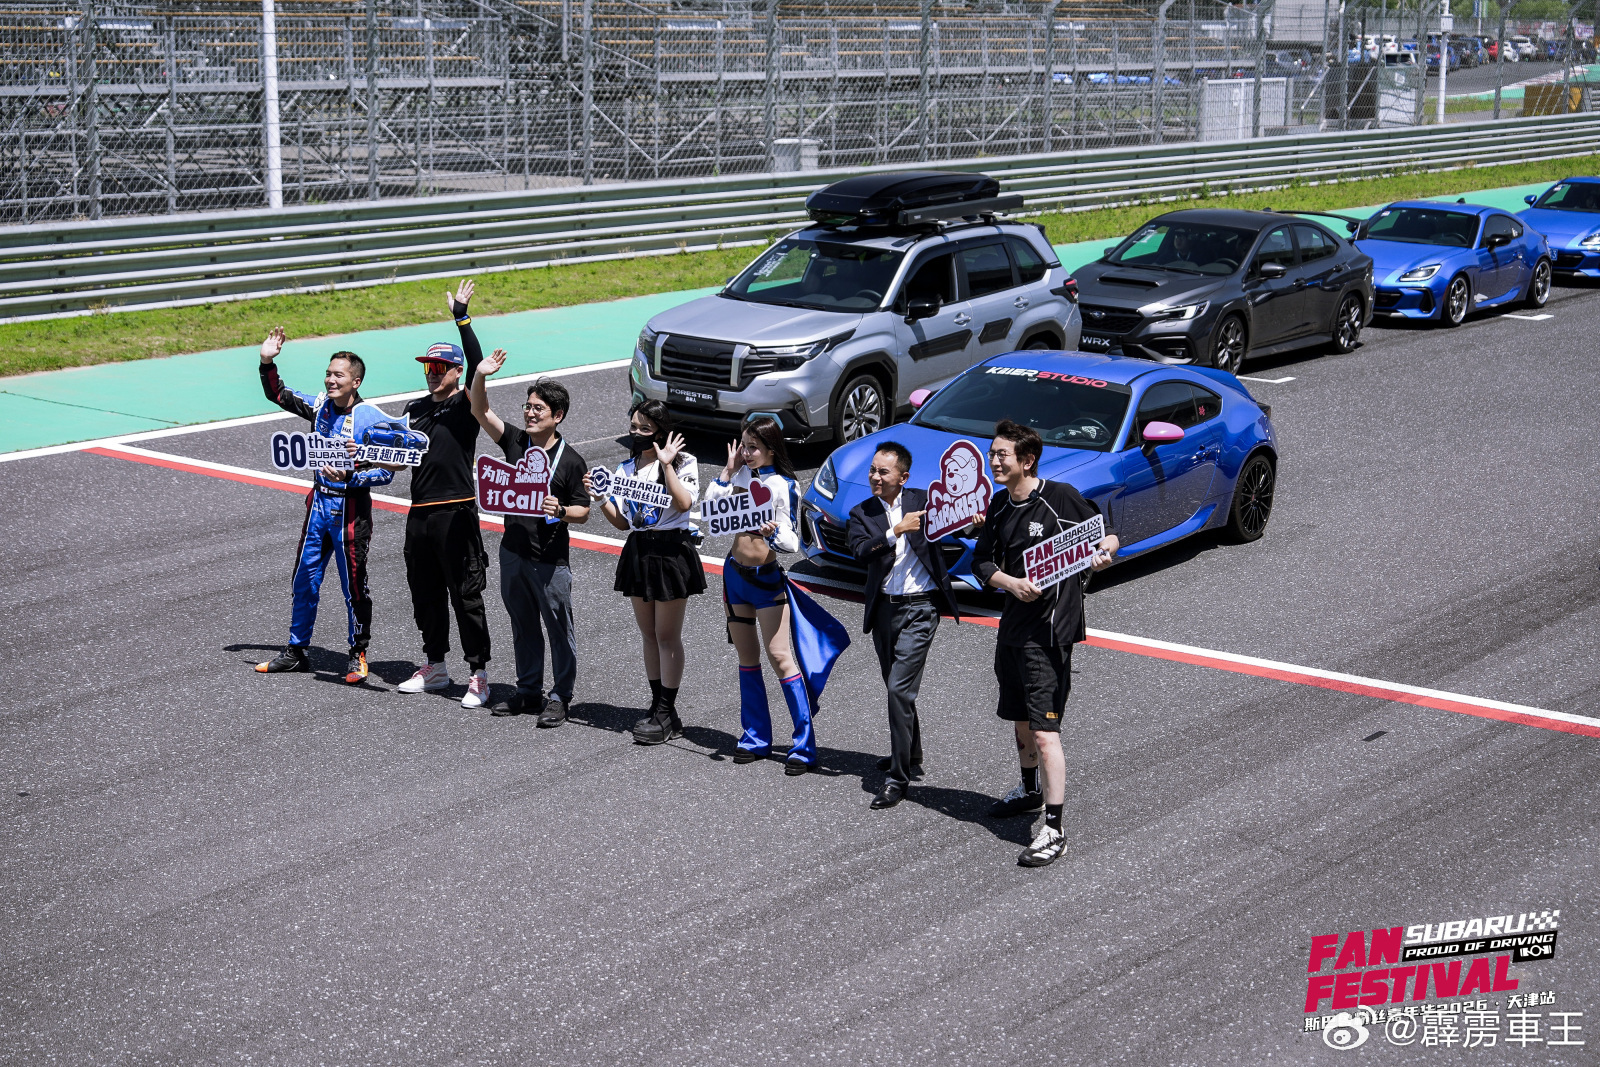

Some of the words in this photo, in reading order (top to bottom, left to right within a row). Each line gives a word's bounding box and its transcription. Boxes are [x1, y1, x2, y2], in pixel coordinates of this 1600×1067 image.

[1082, 336, 1110, 346] WRX
[1035, 371, 1108, 388] STUDIO
[670, 388, 713, 400] FORESTER
[309, 460, 352, 468] BOXER
[353, 446, 422, 465] 为驾趣而生
[481, 464, 511, 486] 为你
[613, 477, 662, 494] SUBARU
[612, 485, 672, 507] 忠实粉丝认证
[702, 502, 708, 517] I
[709, 494, 750, 516] LOVE
[710, 509, 773, 534] SUBARU
[1054, 522, 1090, 547] SUBARU
[1025, 541, 1054, 568] FAN
[1028, 541, 1094, 583] FESTIVAL
